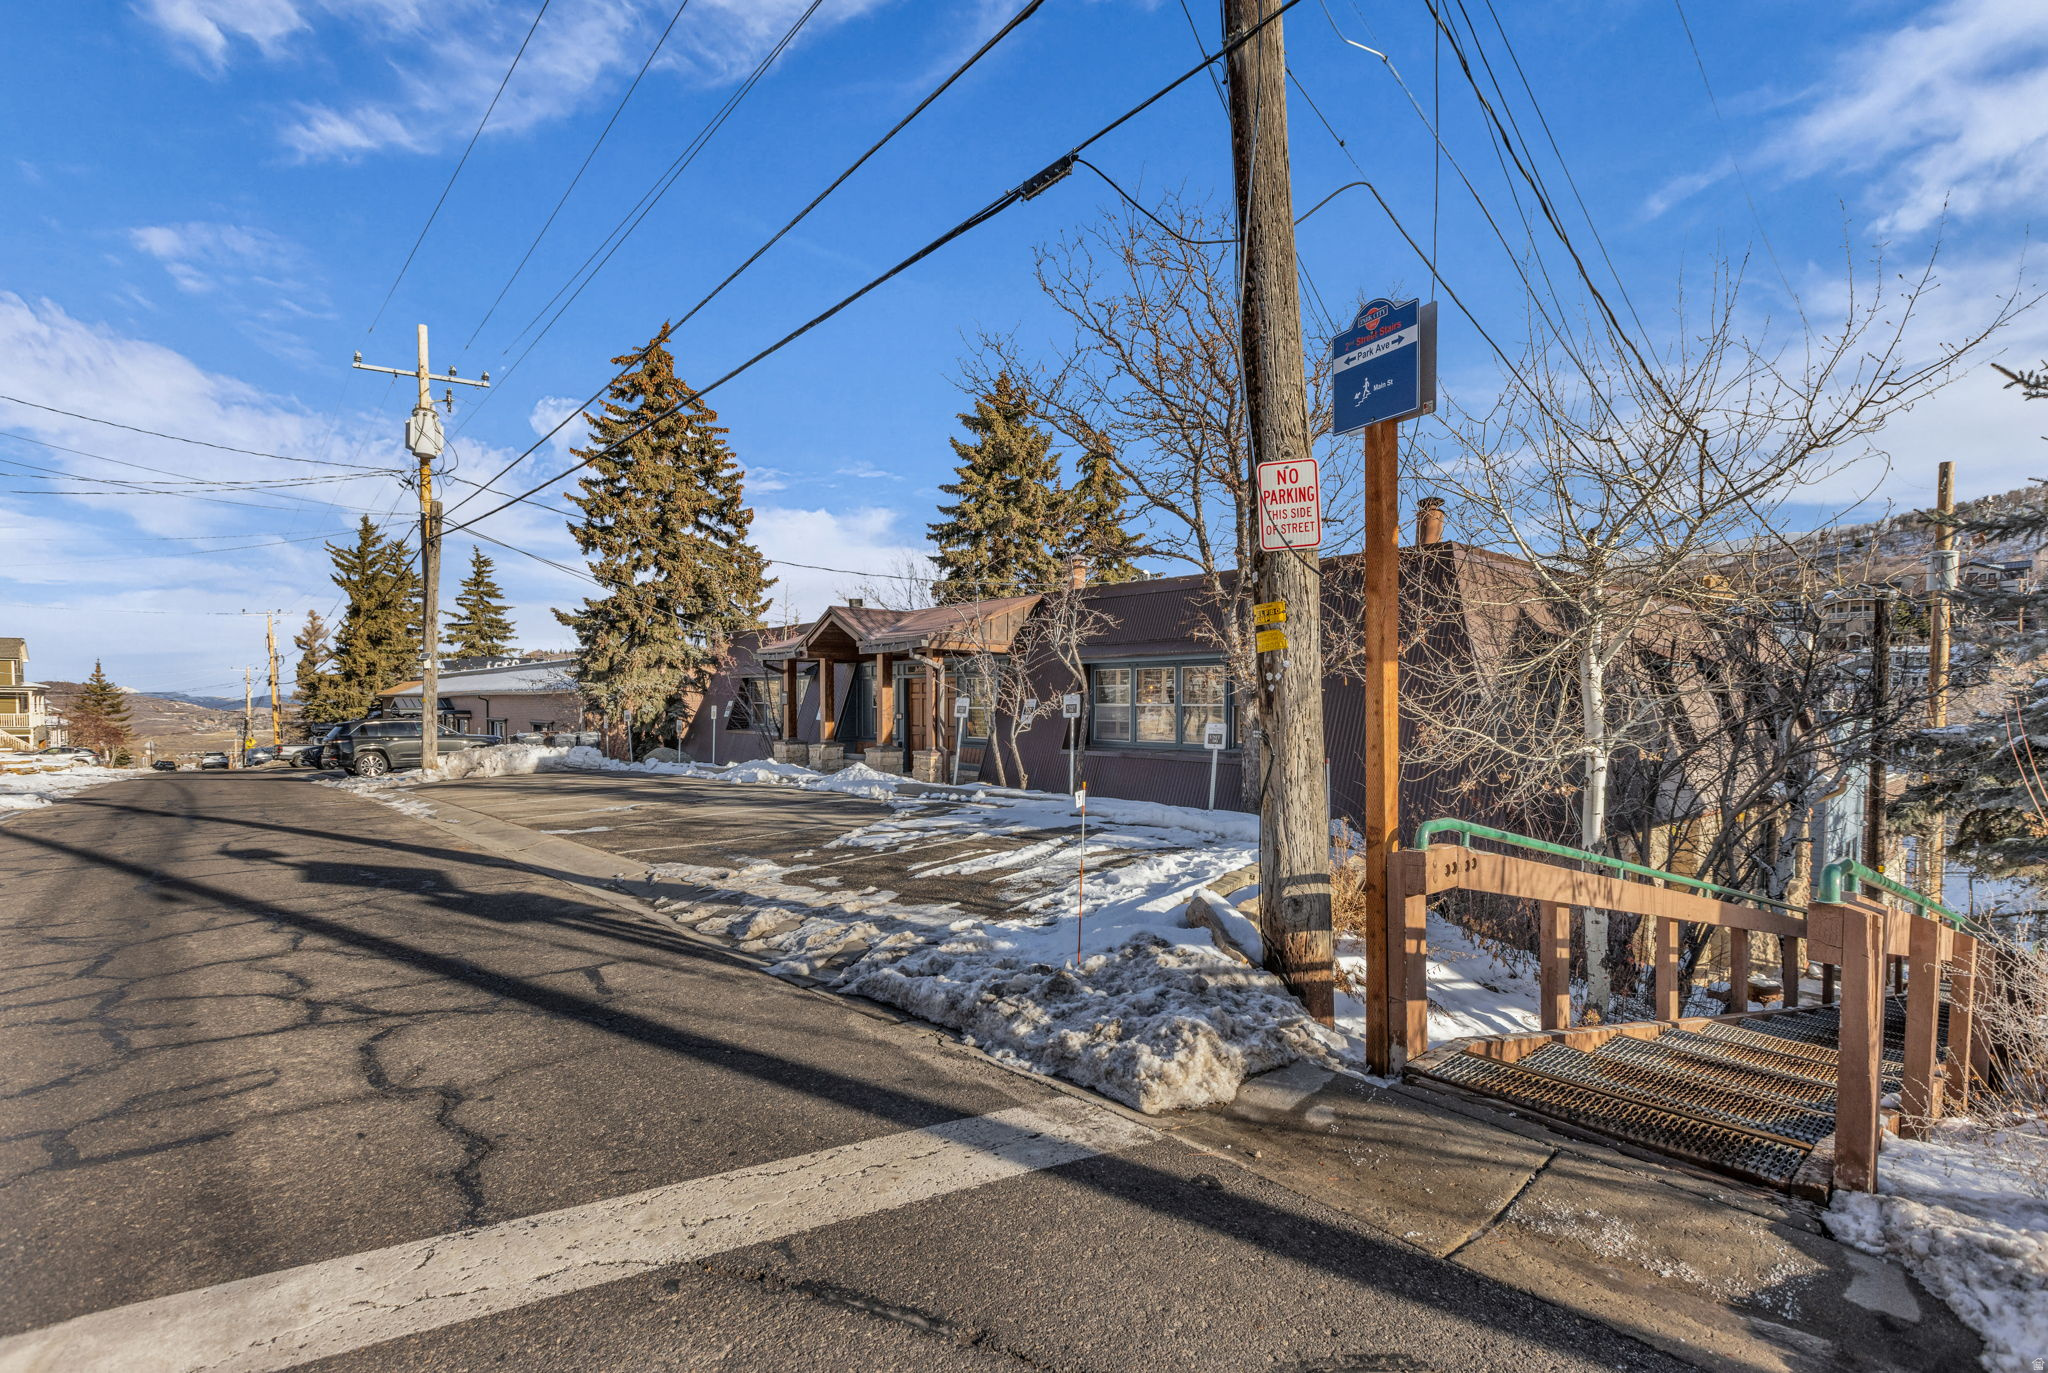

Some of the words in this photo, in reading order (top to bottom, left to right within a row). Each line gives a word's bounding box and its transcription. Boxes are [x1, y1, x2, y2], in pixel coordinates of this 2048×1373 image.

[1356, 332, 1377, 345] Street
[1380, 321, 1401, 336] Stairs
[1357, 347, 1373, 360] Park
[1375, 341, 1390, 354] Ave
[1373, 381, 1386, 391] Main
[1386, 379, 1394, 387] St
[1277, 468, 1299, 485] NO
[1263, 486, 1315, 505] PARKING
[1290, 506, 1313, 519] SIDE
[1266, 524, 1278, 536] OF
[1281, 521, 1315, 534] STREET
